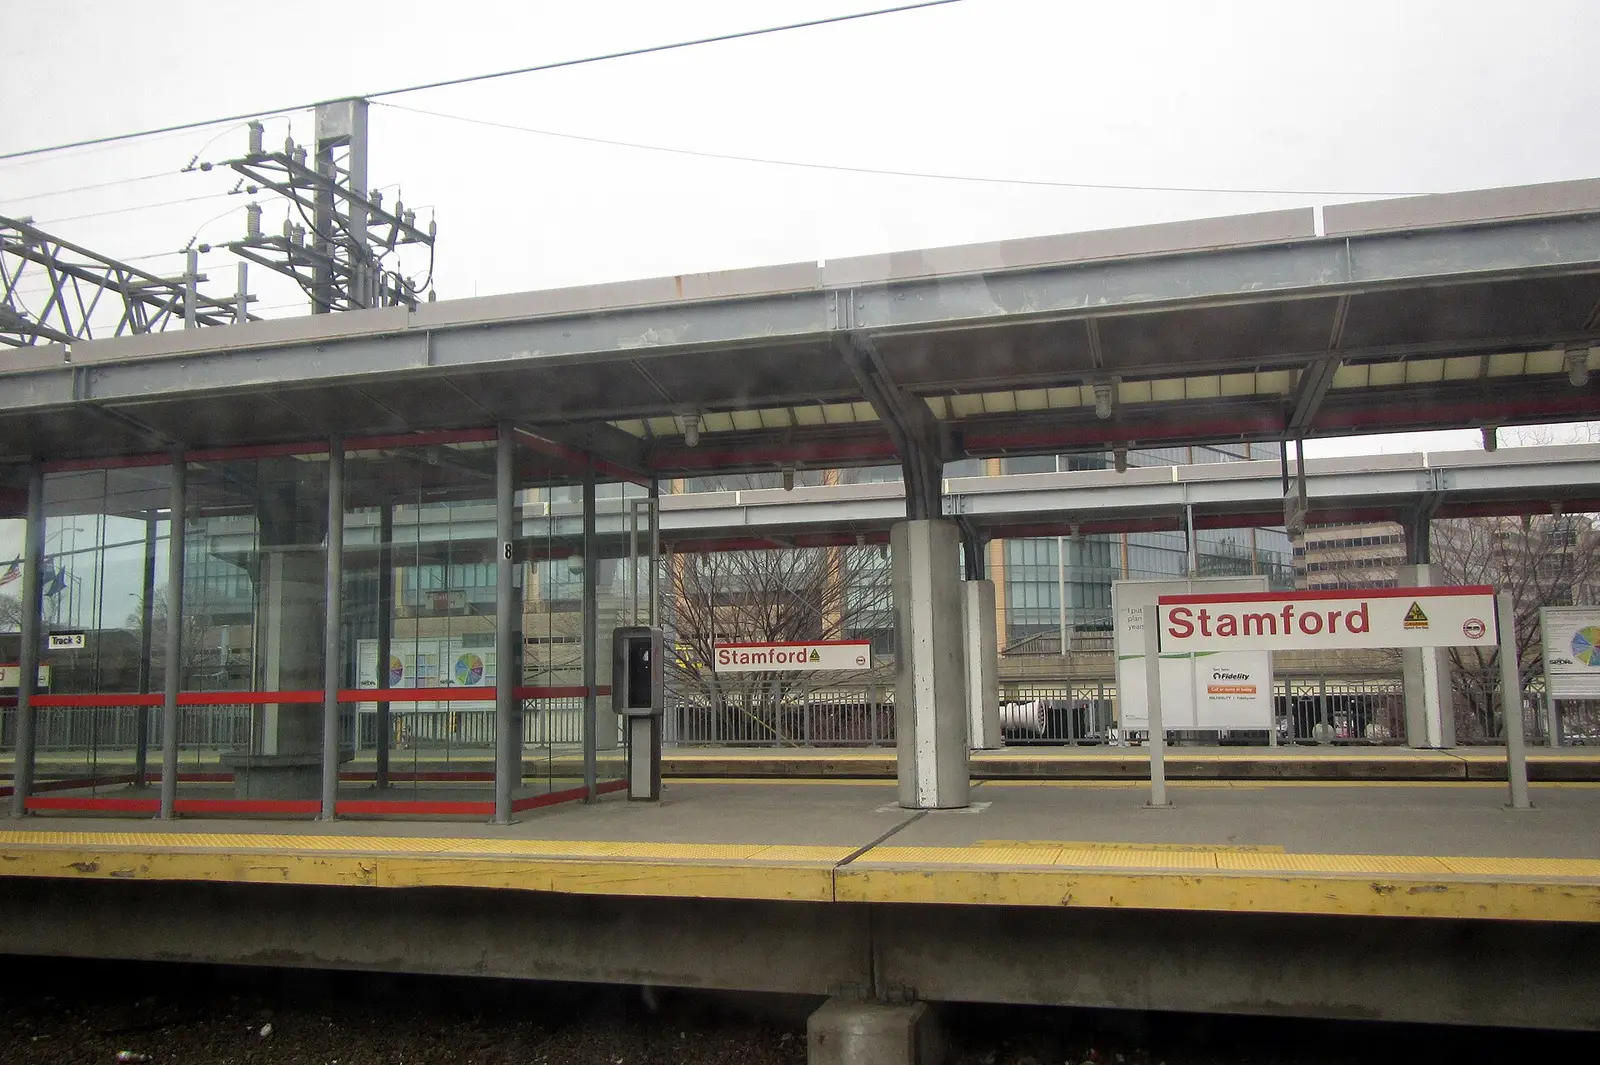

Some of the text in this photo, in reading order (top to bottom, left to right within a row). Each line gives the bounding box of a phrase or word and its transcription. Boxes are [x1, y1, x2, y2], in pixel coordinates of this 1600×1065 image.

[504, 543, 512, 560] 8
[1168, 602, 1369, 639] Stamford
[52, 635, 82, 645] Track 3
[718, 648, 807, 665] Stamford
[1221, 673, 1250, 681] Fidelity
